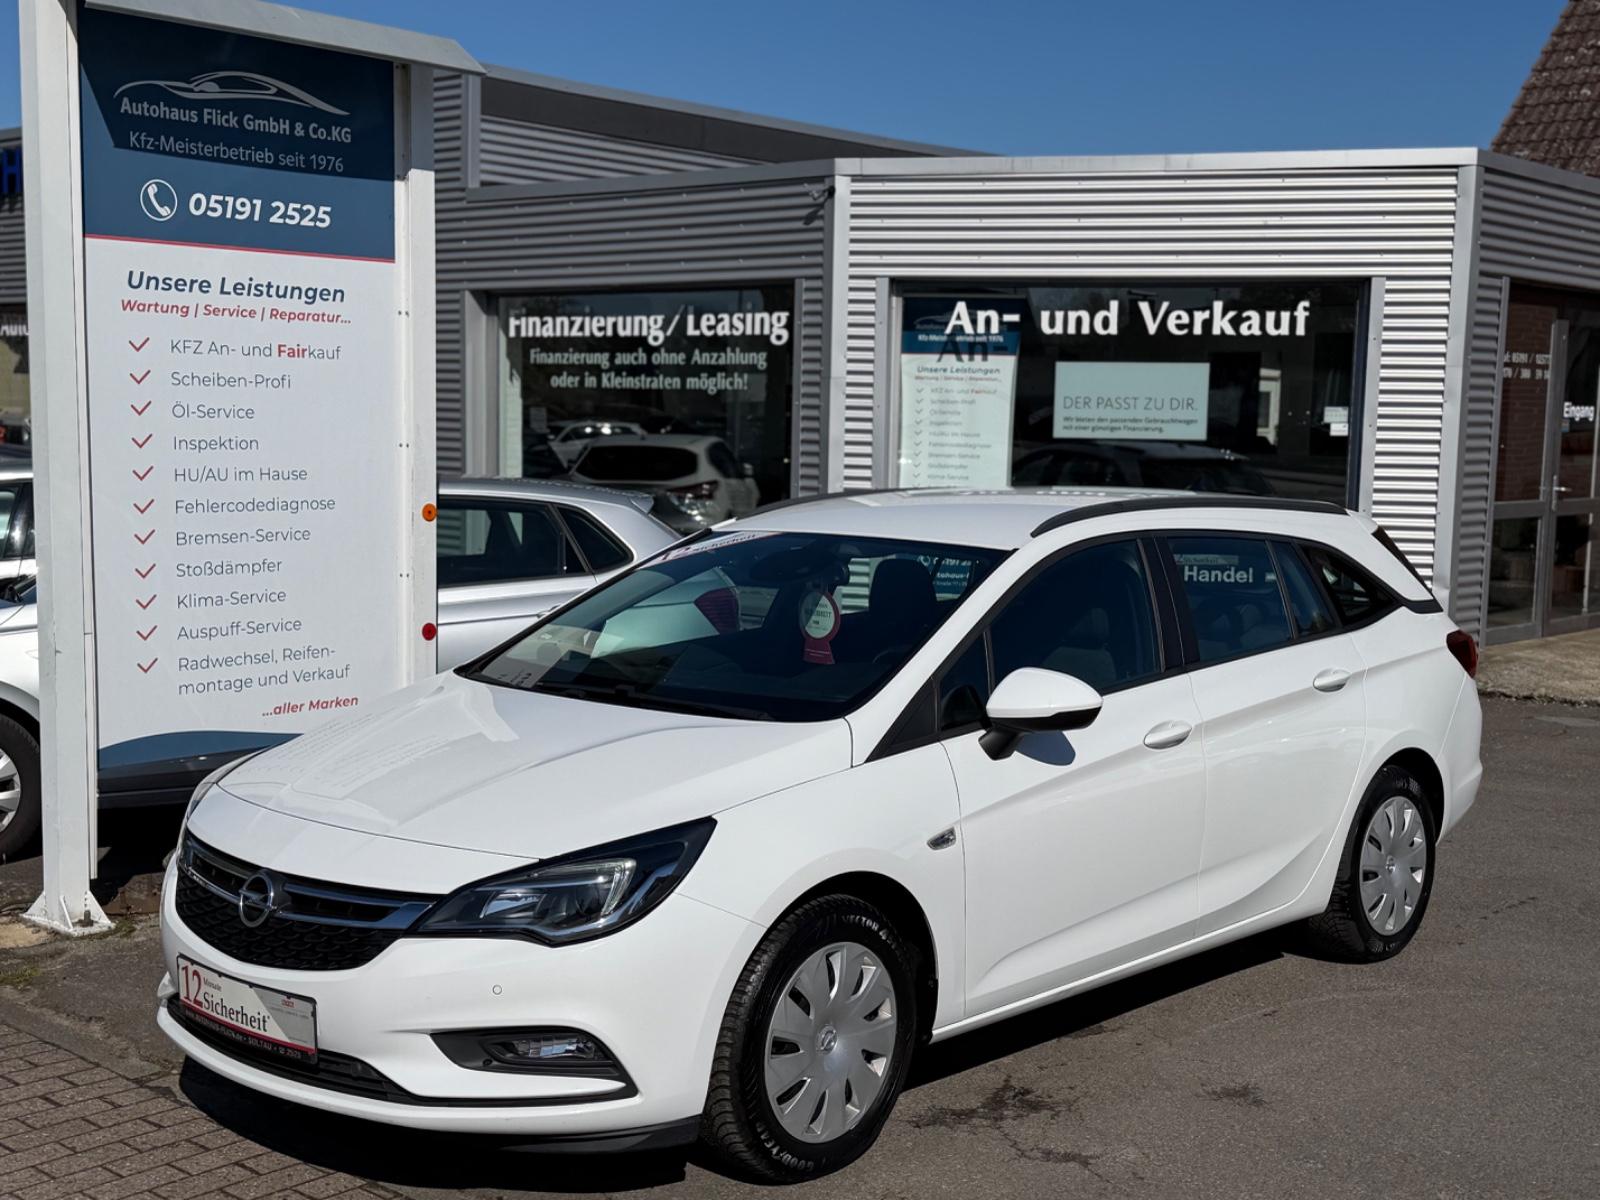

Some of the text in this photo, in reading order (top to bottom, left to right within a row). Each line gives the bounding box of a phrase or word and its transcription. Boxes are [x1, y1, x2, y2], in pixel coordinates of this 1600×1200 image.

[121, 98, 352, 143] Autohaus Flick GmbH & Co.KG
[129, 131, 343, 172] Kfz-Meisterbetrieb seit 1976
[188, 192, 332, 228] 05191 2525
[127, 270, 345, 305] Unsere Leistungen
[121, 299, 189, 318] Wartung
[203, 304, 257, 320] Service
[944, 300, 1310, 336] An- und Verkauf
[170, 339, 342, 360] KFZ An- und Fairkauf
[530, 348, 768, 370] Finanzierung auch ohne Anzahlung
[171, 371, 292, 389] Scheiben-Profi
[550, 372, 748, 395] oder in Kleinstraten möglich!
[172, 401, 255, 420] Öl-Service
[1062, 396, 1198, 412] DER PASST ZU DIR.
[1563, 402, 1595, 421] Eingang
[173, 435, 259, 453] Inspektion
[174, 466, 308, 483] HU/AU im Hause
[175, 497, 336, 514] Fehlercodediagnose
[176, 528, 312, 546] Bremsen-Service
[176, 558, 283, 578] Stoßdämpfer
[1184, 565, 1254, 583] Handel
[177, 589, 287, 609] Klima-Service
[177, 618, 302, 641] Auspuff-Service
[178, 644, 336, 672] Radwechsel, Reifen-
[178, 664, 351, 696] montage und Verkauf
[308, 696, 358, 712] Marken
[181, 965, 204, 1009] 12
[756, 1121, 814, 1171] GOODYEAR
